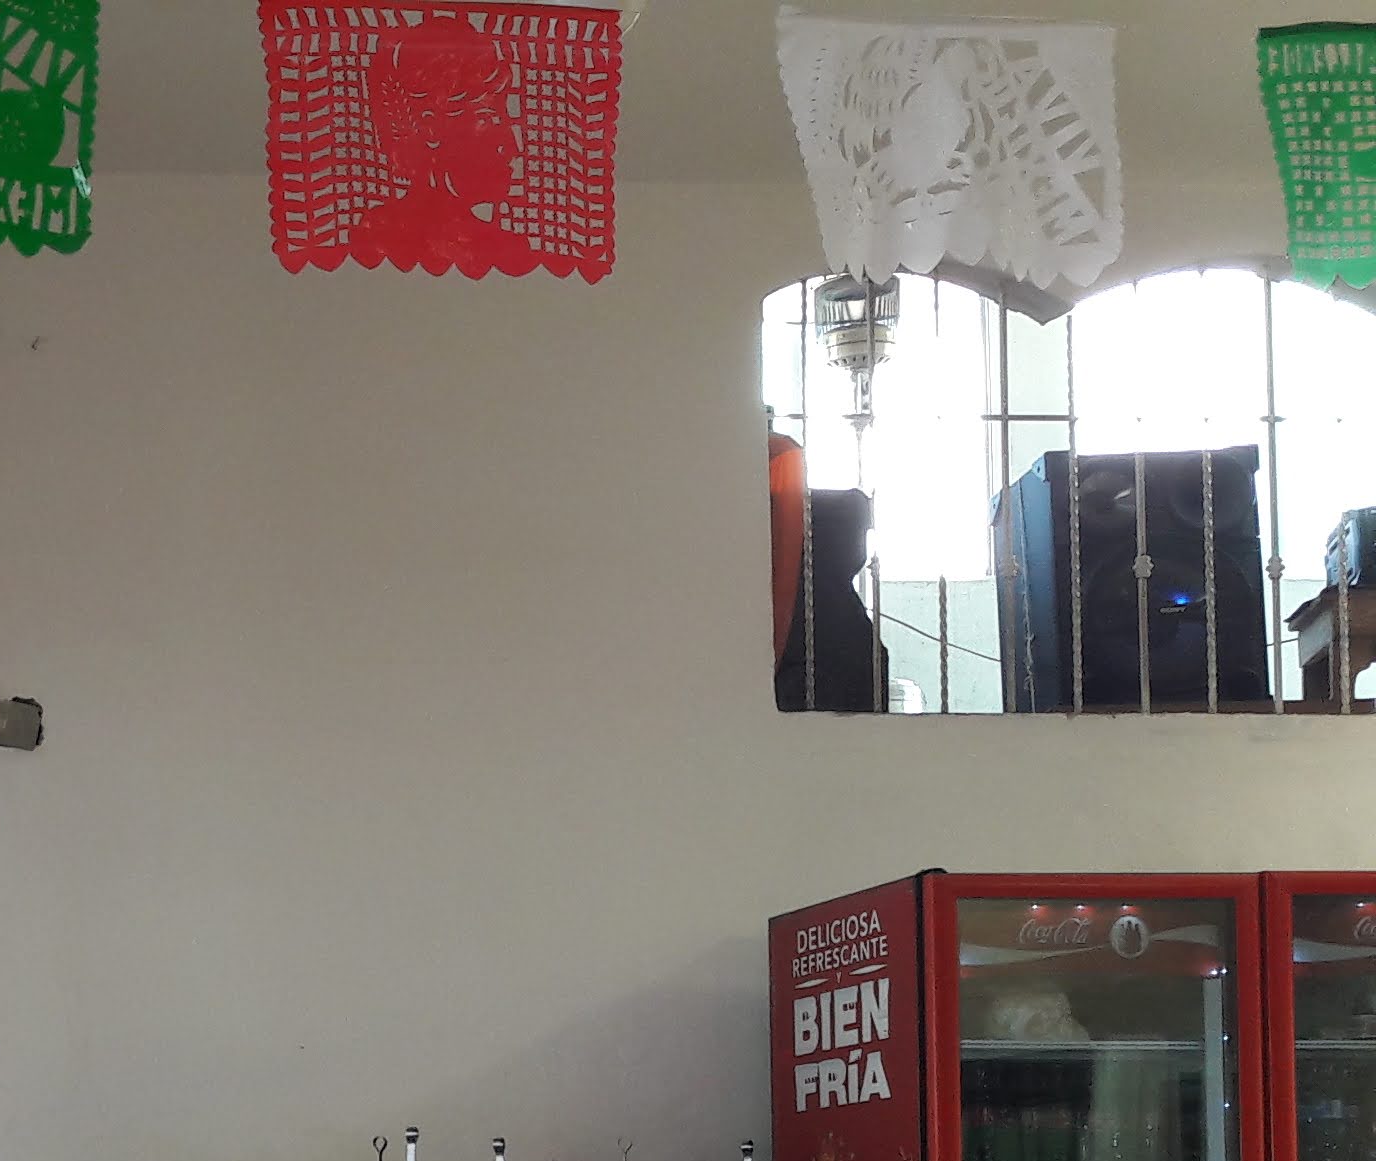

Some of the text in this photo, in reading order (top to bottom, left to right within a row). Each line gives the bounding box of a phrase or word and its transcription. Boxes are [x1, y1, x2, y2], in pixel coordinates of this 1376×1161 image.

[791, 935, 888, 979] REFRESCANTE
[796, 910, 882, 956] DELICIOSA
[793, 977, 891, 1057] BIEN
[793, 1047, 892, 1113] FRÍA
